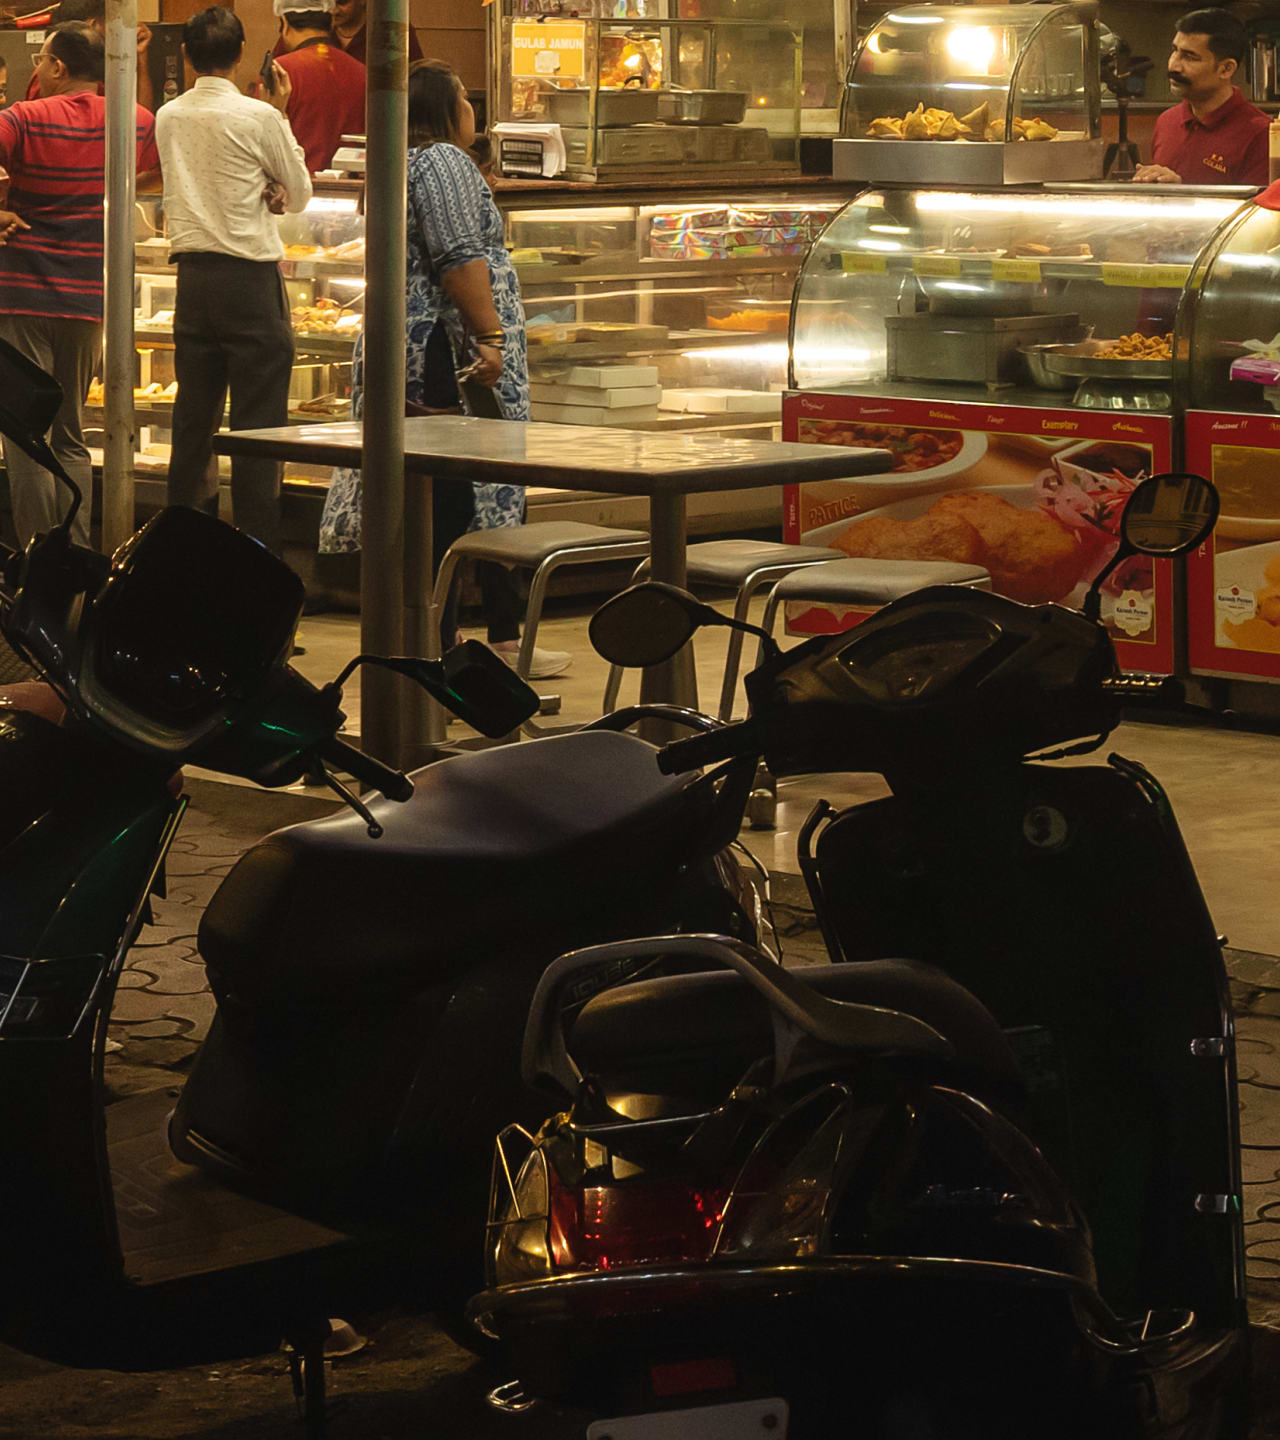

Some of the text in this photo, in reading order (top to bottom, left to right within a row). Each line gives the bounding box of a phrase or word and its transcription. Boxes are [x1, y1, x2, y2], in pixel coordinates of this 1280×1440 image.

[514, 37, 585, 50] GULAB JAMUN
[1041, 418, 1079, 431] Exemplary
[808, 495, 861, 526] PATTICE
